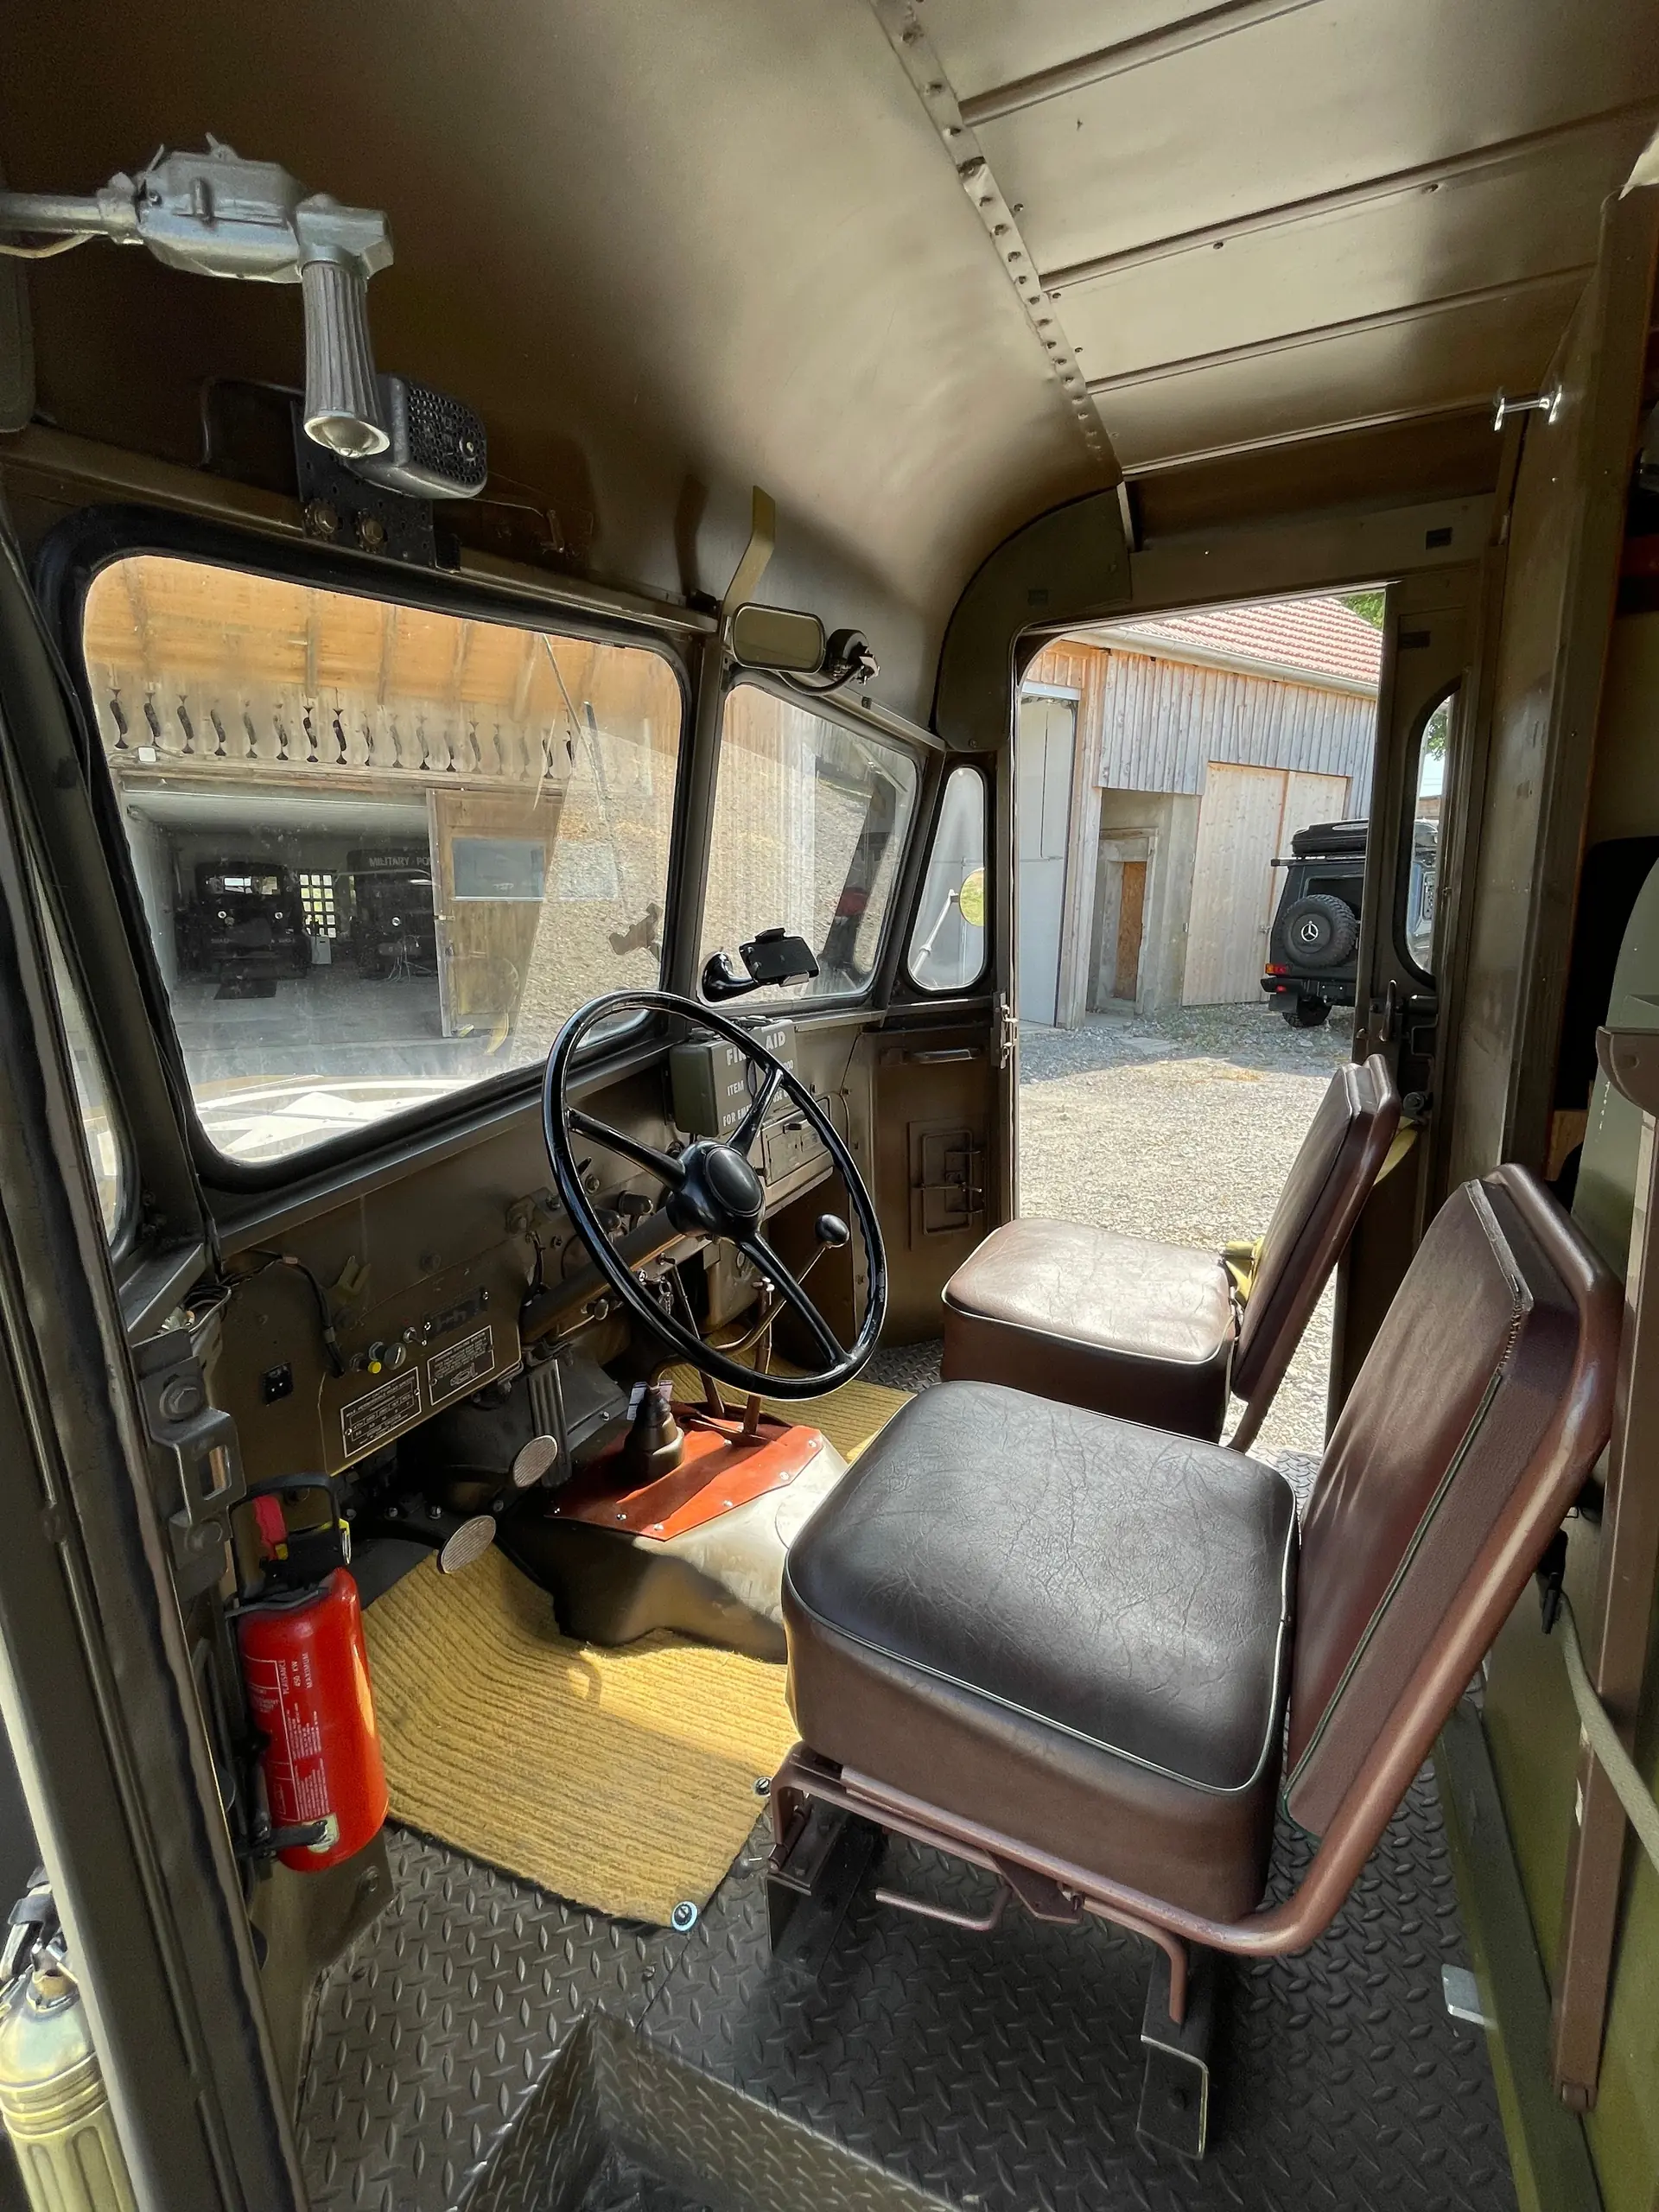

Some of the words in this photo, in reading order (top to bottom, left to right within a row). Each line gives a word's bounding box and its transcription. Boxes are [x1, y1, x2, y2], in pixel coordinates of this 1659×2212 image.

[369, 856, 410, 867] MILITARY
[766, 1031, 786, 1051] AID
[727, 1080, 744, 1096] ITEM
[722, 1111, 736, 1127] FOR
[291, 1661, 299, 1672] KW
[302, 1652, 313, 1688] MAXIMUM
[277, 1658, 289, 1695] PLAISANCE
